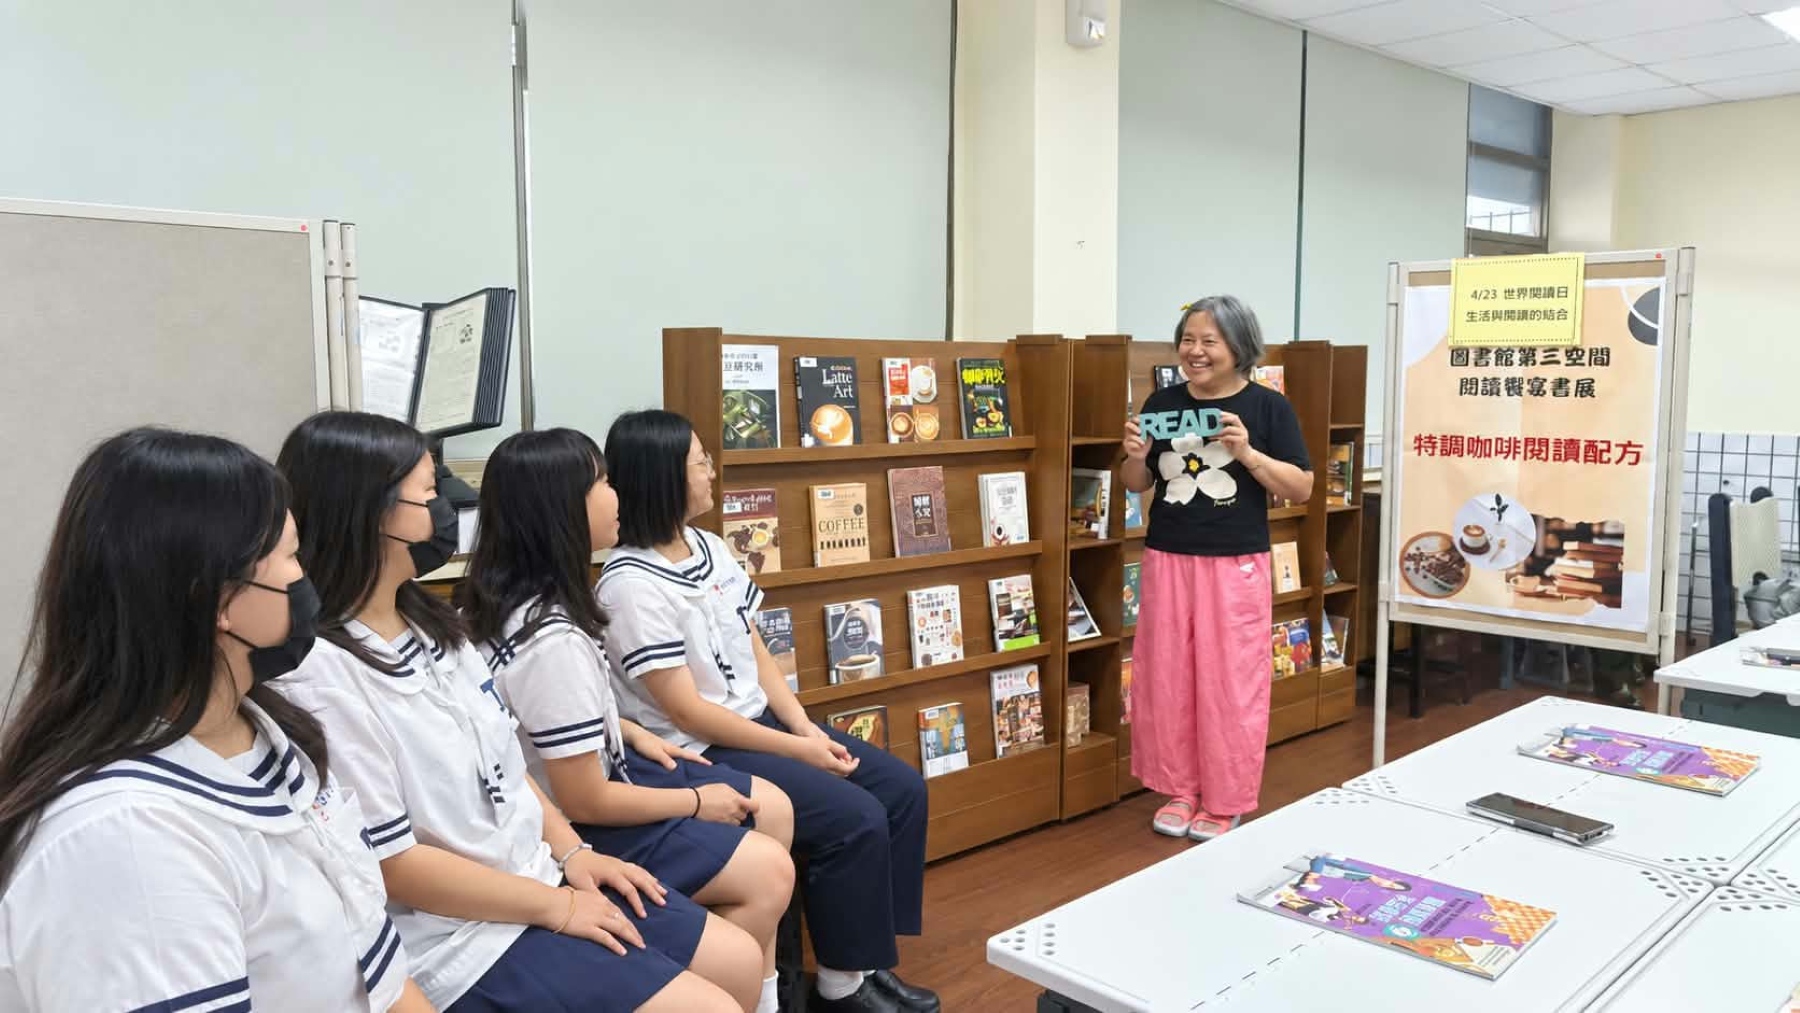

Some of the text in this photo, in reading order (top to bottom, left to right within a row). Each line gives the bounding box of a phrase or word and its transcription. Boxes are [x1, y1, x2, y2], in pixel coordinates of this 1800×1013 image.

[1470, 286, 1569, 301] 4/23 世界閱讀日
[1450, 347, 1611, 368] 圖書館第三空間
[822, 368, 853, 385] Latte
[833, 384, 854, 398] Art
[1459, 377, 1596, 398] 閱讀饗宴書展
[1138, 407, 1224, 441] READ
[1413, 433, 1644, 466] 特調咖啡閱讀配方
[818, 517, 864, 533] COFFEE
